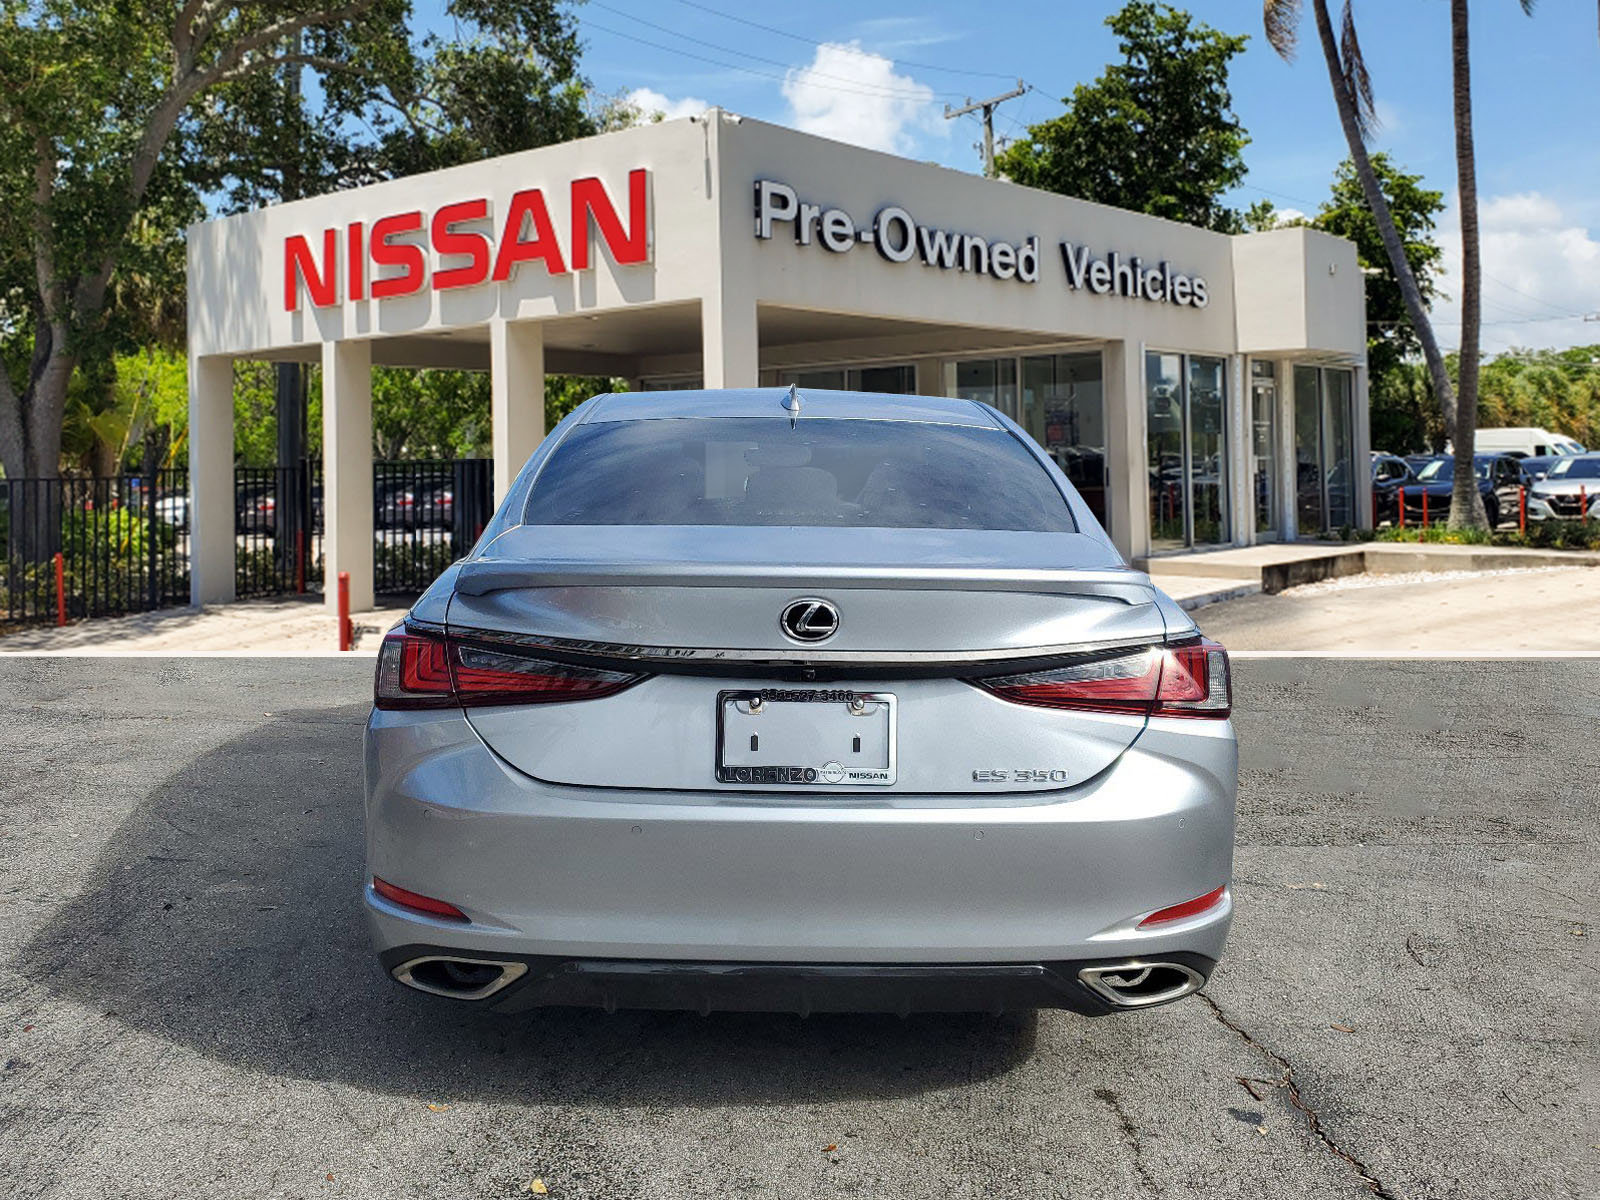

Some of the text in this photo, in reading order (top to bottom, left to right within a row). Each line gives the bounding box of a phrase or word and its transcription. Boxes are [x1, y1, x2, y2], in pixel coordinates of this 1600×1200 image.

[284, 168, 648, 312] NISSAN
[754, 179, 1209, 308] Pre-Owned Vehicles
[724, 766, 816, 783] LORENZO
[848, 772, 889, 780] NISSAN
[971, 769, 1069, 783] ES 350
